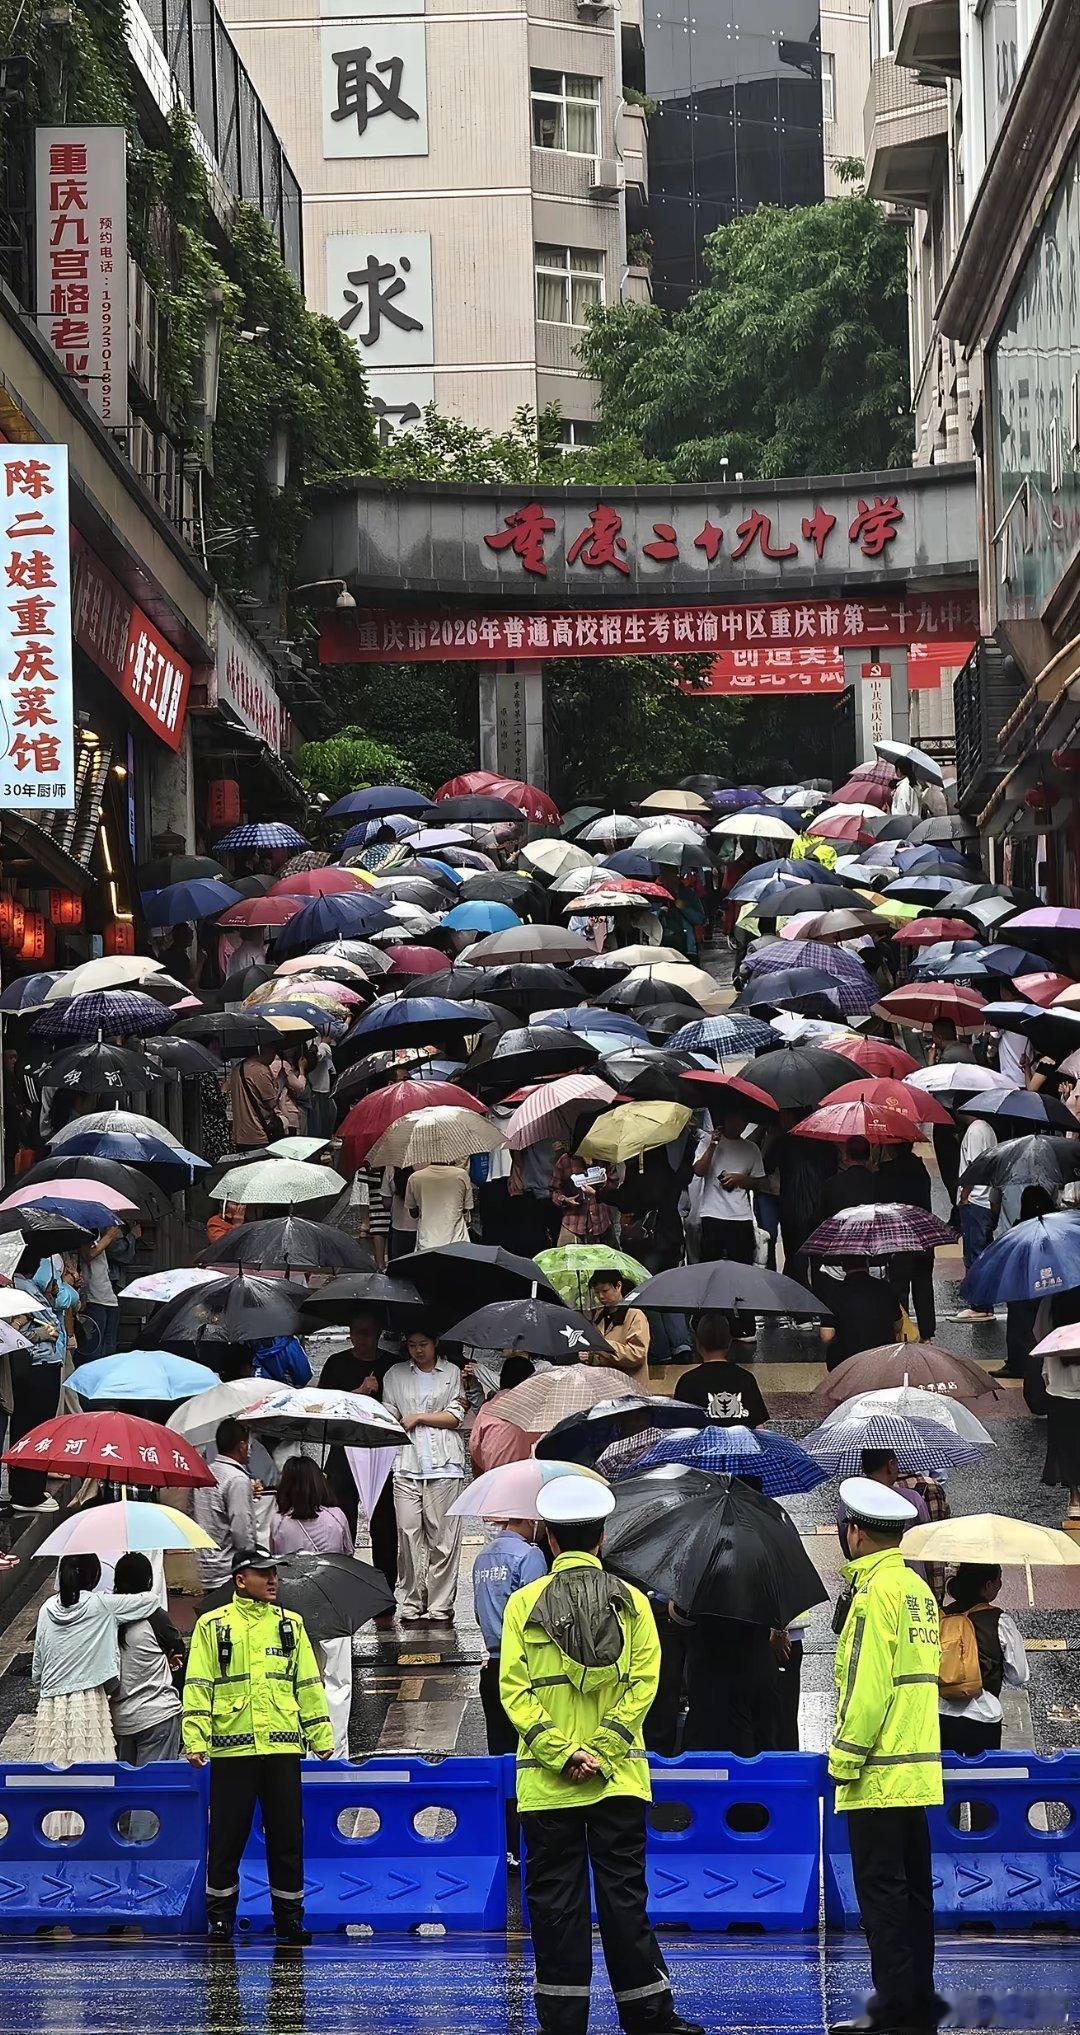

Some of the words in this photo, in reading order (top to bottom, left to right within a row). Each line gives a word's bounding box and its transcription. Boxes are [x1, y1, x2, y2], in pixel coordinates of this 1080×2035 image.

[331, 47, 420, 136] 取
[338, 254, 424, 347] 求
[4, 459, 61, 774] 陈二娃重庆菜馆
[4, 784, 66, 798] 30年厨师
[906, 1594, 937, 1624] 警察
